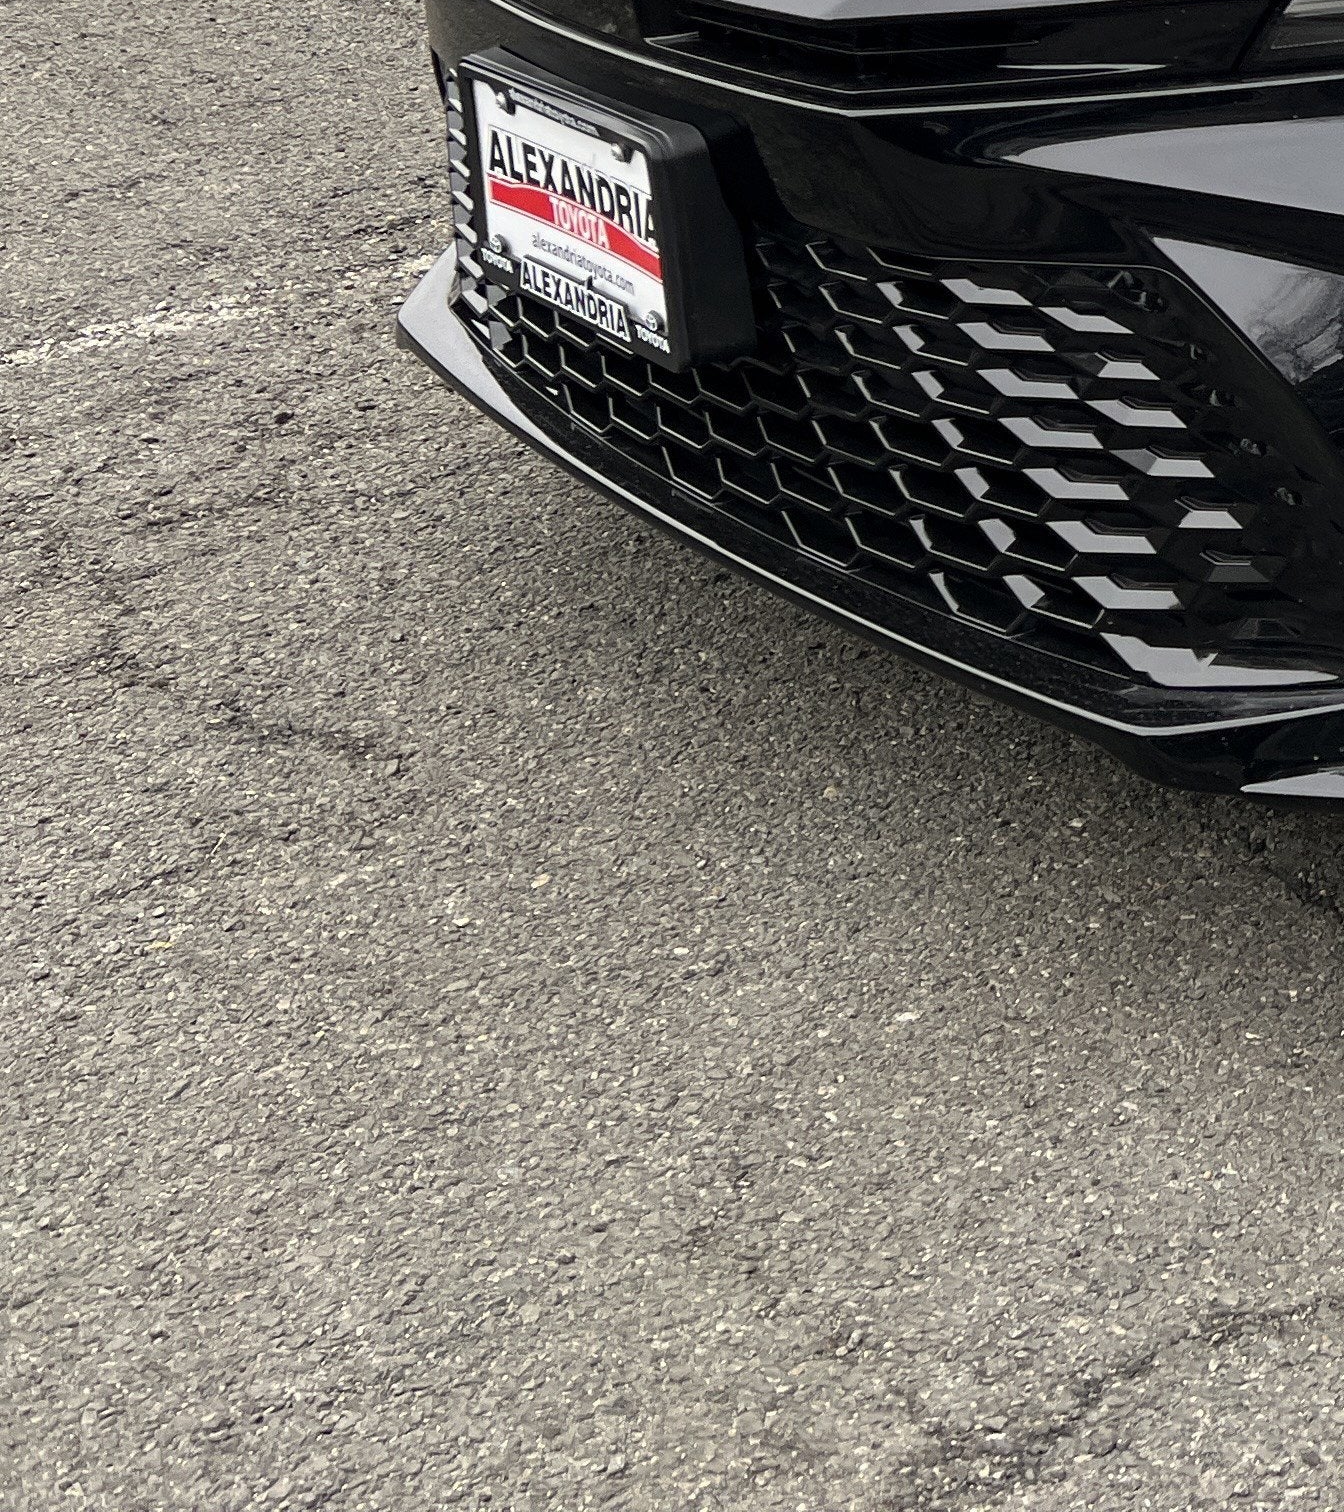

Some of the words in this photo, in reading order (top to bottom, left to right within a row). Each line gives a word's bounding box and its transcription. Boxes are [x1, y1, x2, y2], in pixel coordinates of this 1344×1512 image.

[549, 196, 612, 251] TOYOTA
[531, 232, 636, 296] alexandriatoyota.com
[521, 259, 630, 337] ALEXANDRIA
